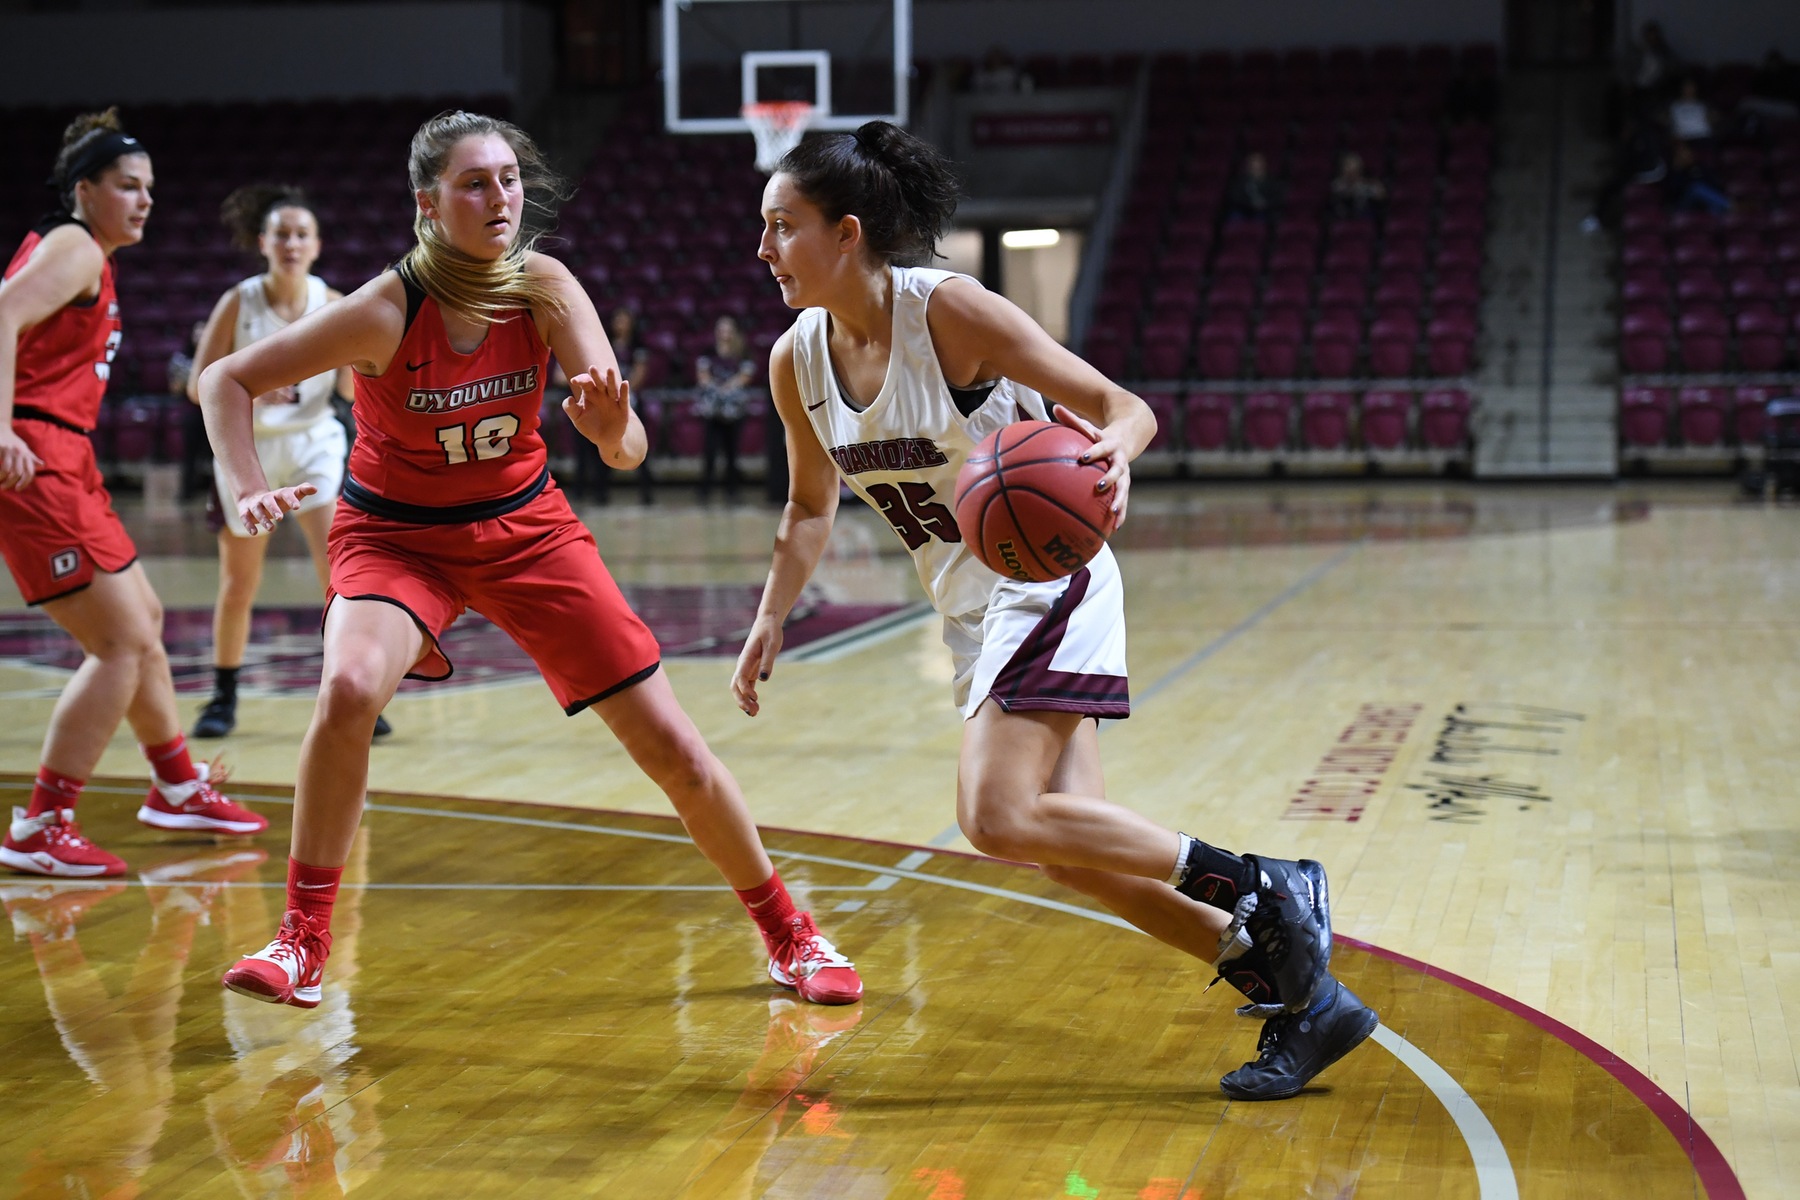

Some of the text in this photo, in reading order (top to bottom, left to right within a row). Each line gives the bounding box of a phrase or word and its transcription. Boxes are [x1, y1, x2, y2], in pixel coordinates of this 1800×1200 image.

[405, 366, 539, 412] D'YOUVILLE
[866, 482, 962, 550] 35
[51, 550, 78, 578] D
